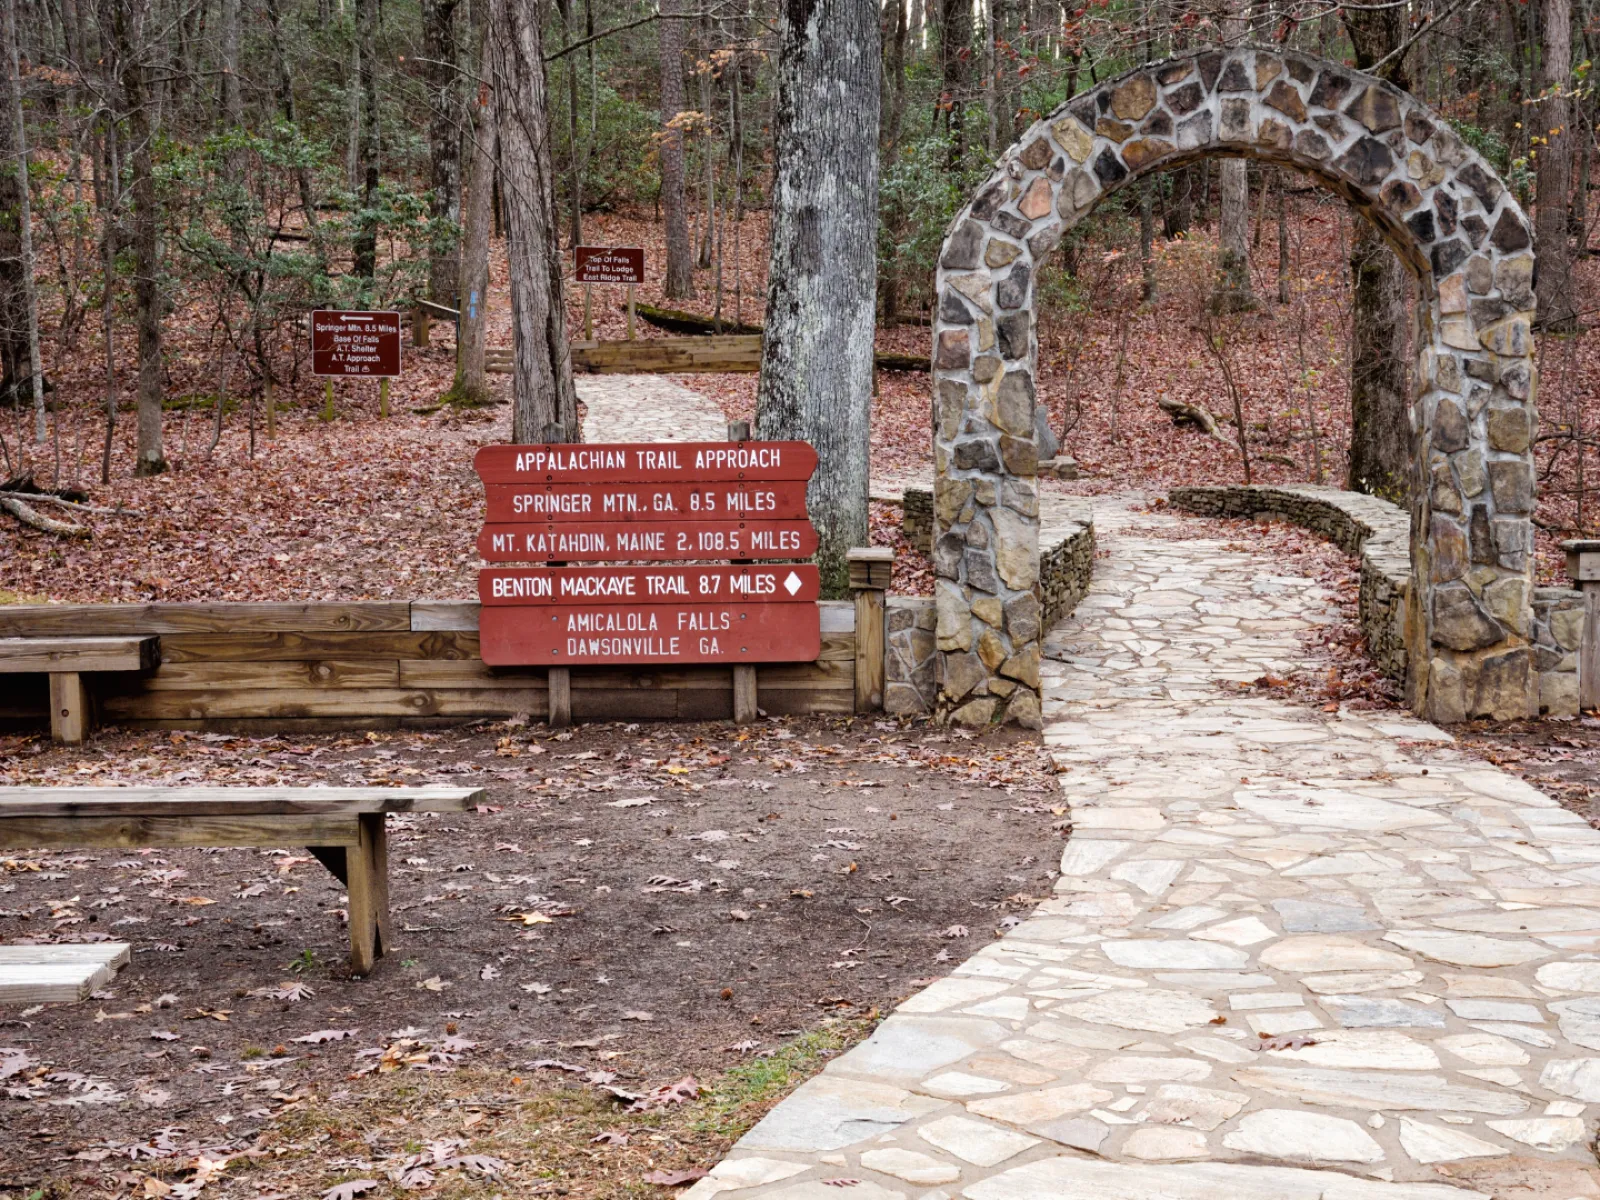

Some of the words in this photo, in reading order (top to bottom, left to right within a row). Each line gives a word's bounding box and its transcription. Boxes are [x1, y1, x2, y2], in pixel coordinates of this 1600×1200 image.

[613, 256, 630, 264] Falls
[600, 274, 621, 282] Ridge
[315, 323, 346, 333] Springer
[347, 324, 363, 332] Mtn.
[365, 324, 377, 332] 8.5
[333, 335, 351, 343] Base
[352, 335, 362, 343] Of
[363, 335, 379, 343] Falls
[336, 344, 351, 352] A.T.
[351, 345, 377, 353] Shelter
[331, 354, 345, 362] A.T.
[346, 354, 381, 363] Approach
[344, 365, 360, 373] Trail
[515, 450, 626, 472] APPALACHIAN
[637, 450, 682, 469] TRAIL
[695, 449, 781, 469] APPROACH
[513, 494, 592, 513] SPRINGER
[653, 493, 679, 511] GA.
[689, 492, 716, 511] 8.5
[727, 491, 776, 511] MILES
[492, 533, 521, 553] MT.
[526, 532, 611, 552] KATAHDIN,
[617, 532, 665, 551] MAINE
[676, 531, 740, 551] 2,108.5
[751, 531, 800, 550] MILES
[492, 577, 552, 597] BENTON
[560, 576, 636, 596] MACKAYE
[645, 575, 690, 595] TRAIL
[699, 575, 721, 595] 8.7
[729, 573, 776, 594] MILES
[567, 612, 658, 632] AMICALOLA
[677, 612, 730, 630] FALLS
[567, 636, 680, 656] DAWSONVILLE
[699, 637, 724, 655] GA.
